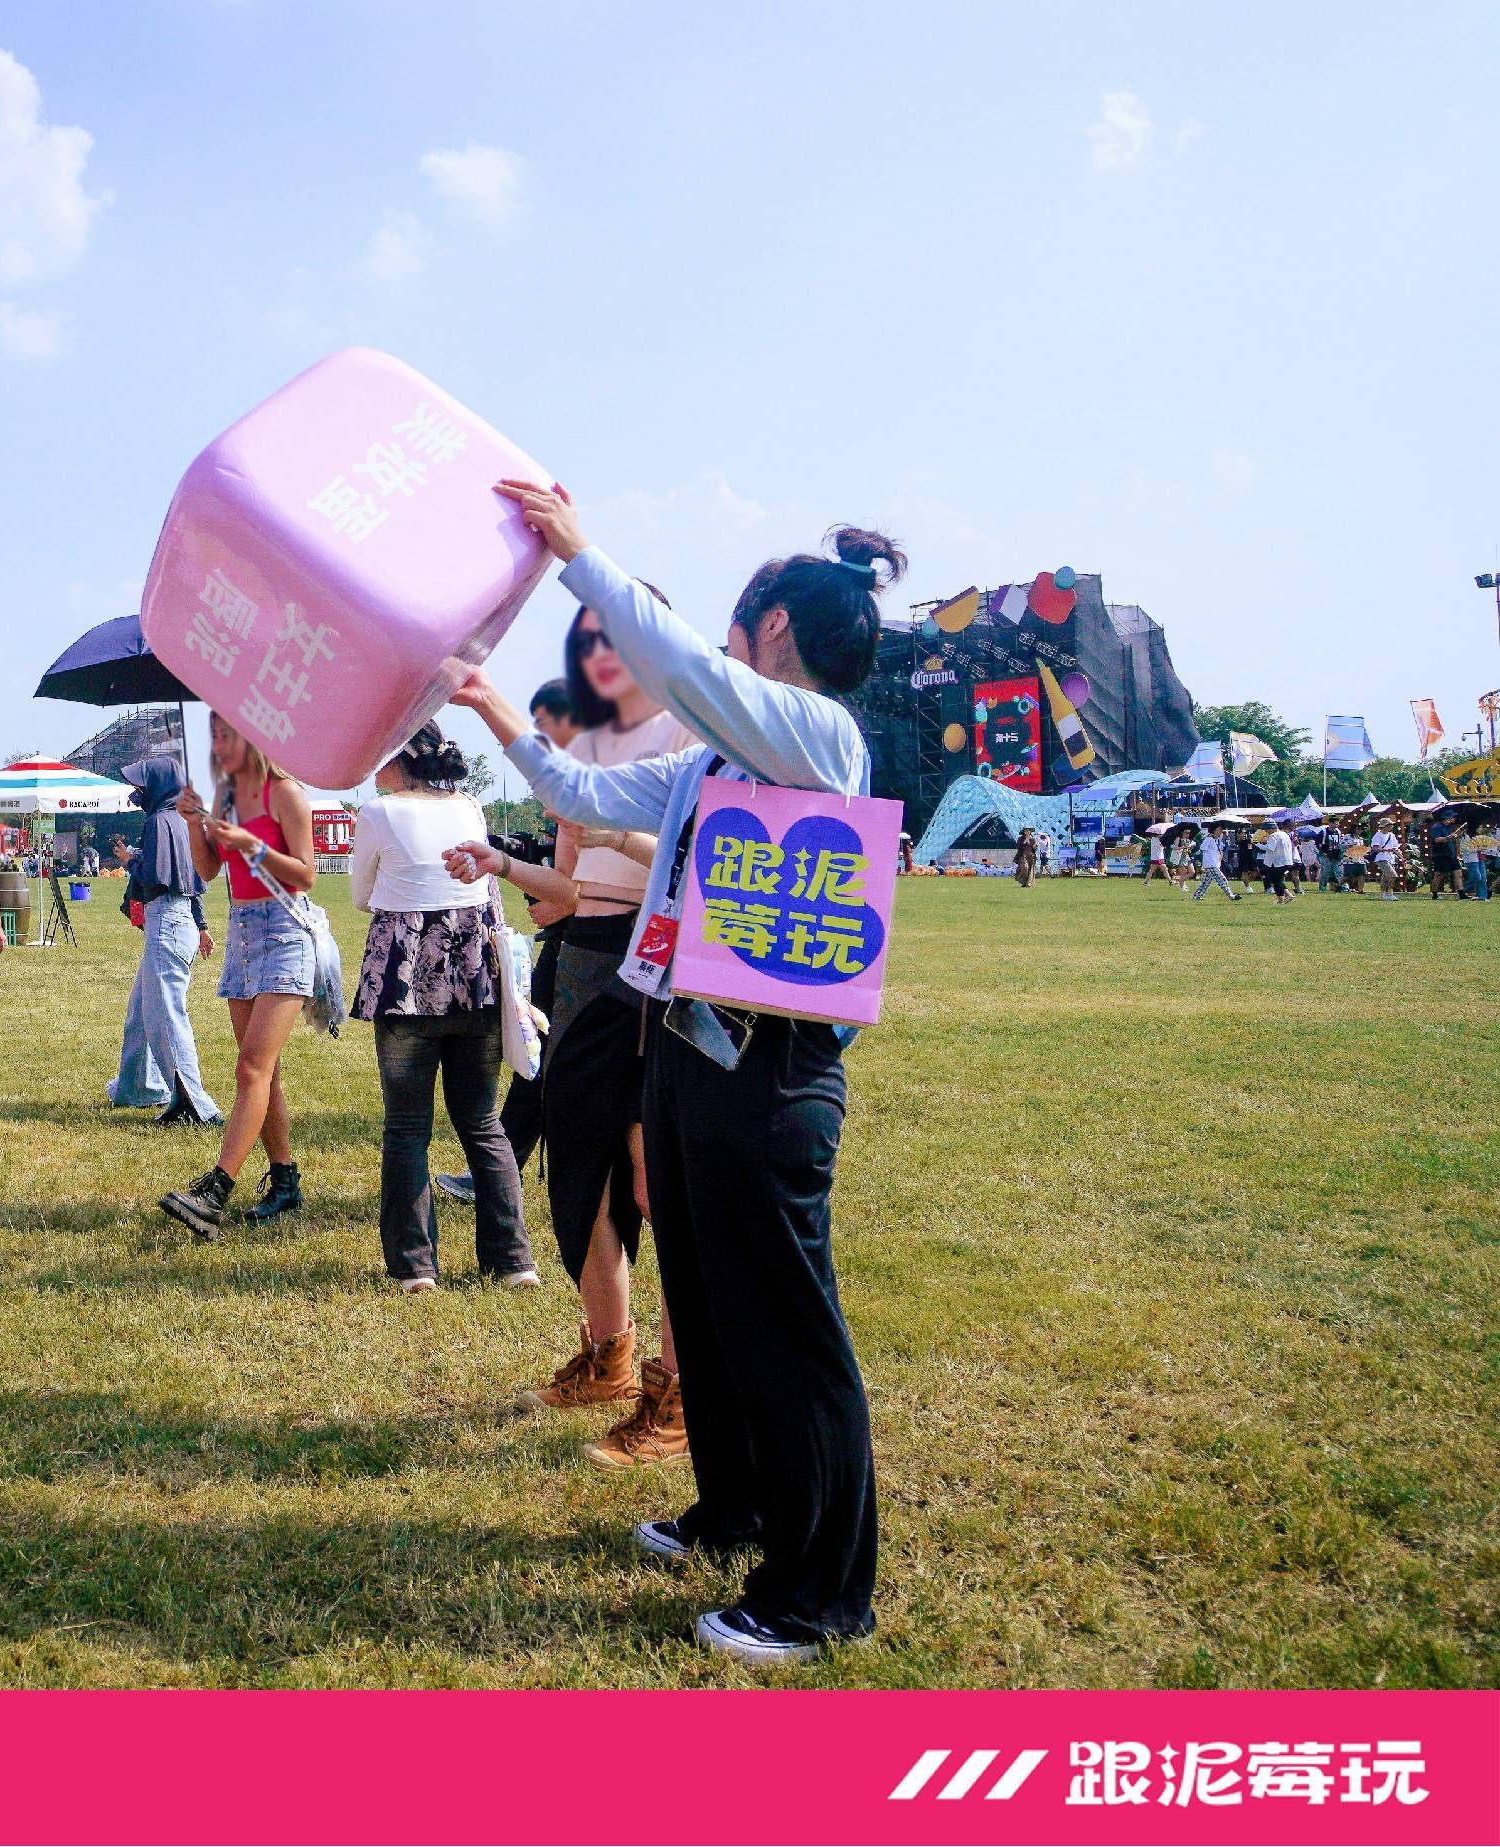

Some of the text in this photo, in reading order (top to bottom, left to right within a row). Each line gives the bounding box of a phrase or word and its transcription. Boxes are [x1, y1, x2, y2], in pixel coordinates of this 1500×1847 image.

[306, 400, 469, 545] 美妆蛋
[184, 568, 261, 679] 唇泥
[238, 601, 340, 745] 女主角
[911, 670, 957, 691] Corona
[313, 813, 332, 821] PRO
[704, 834, 870, 906] 跟泥
[701, 897, 866, 975] 莓玩
